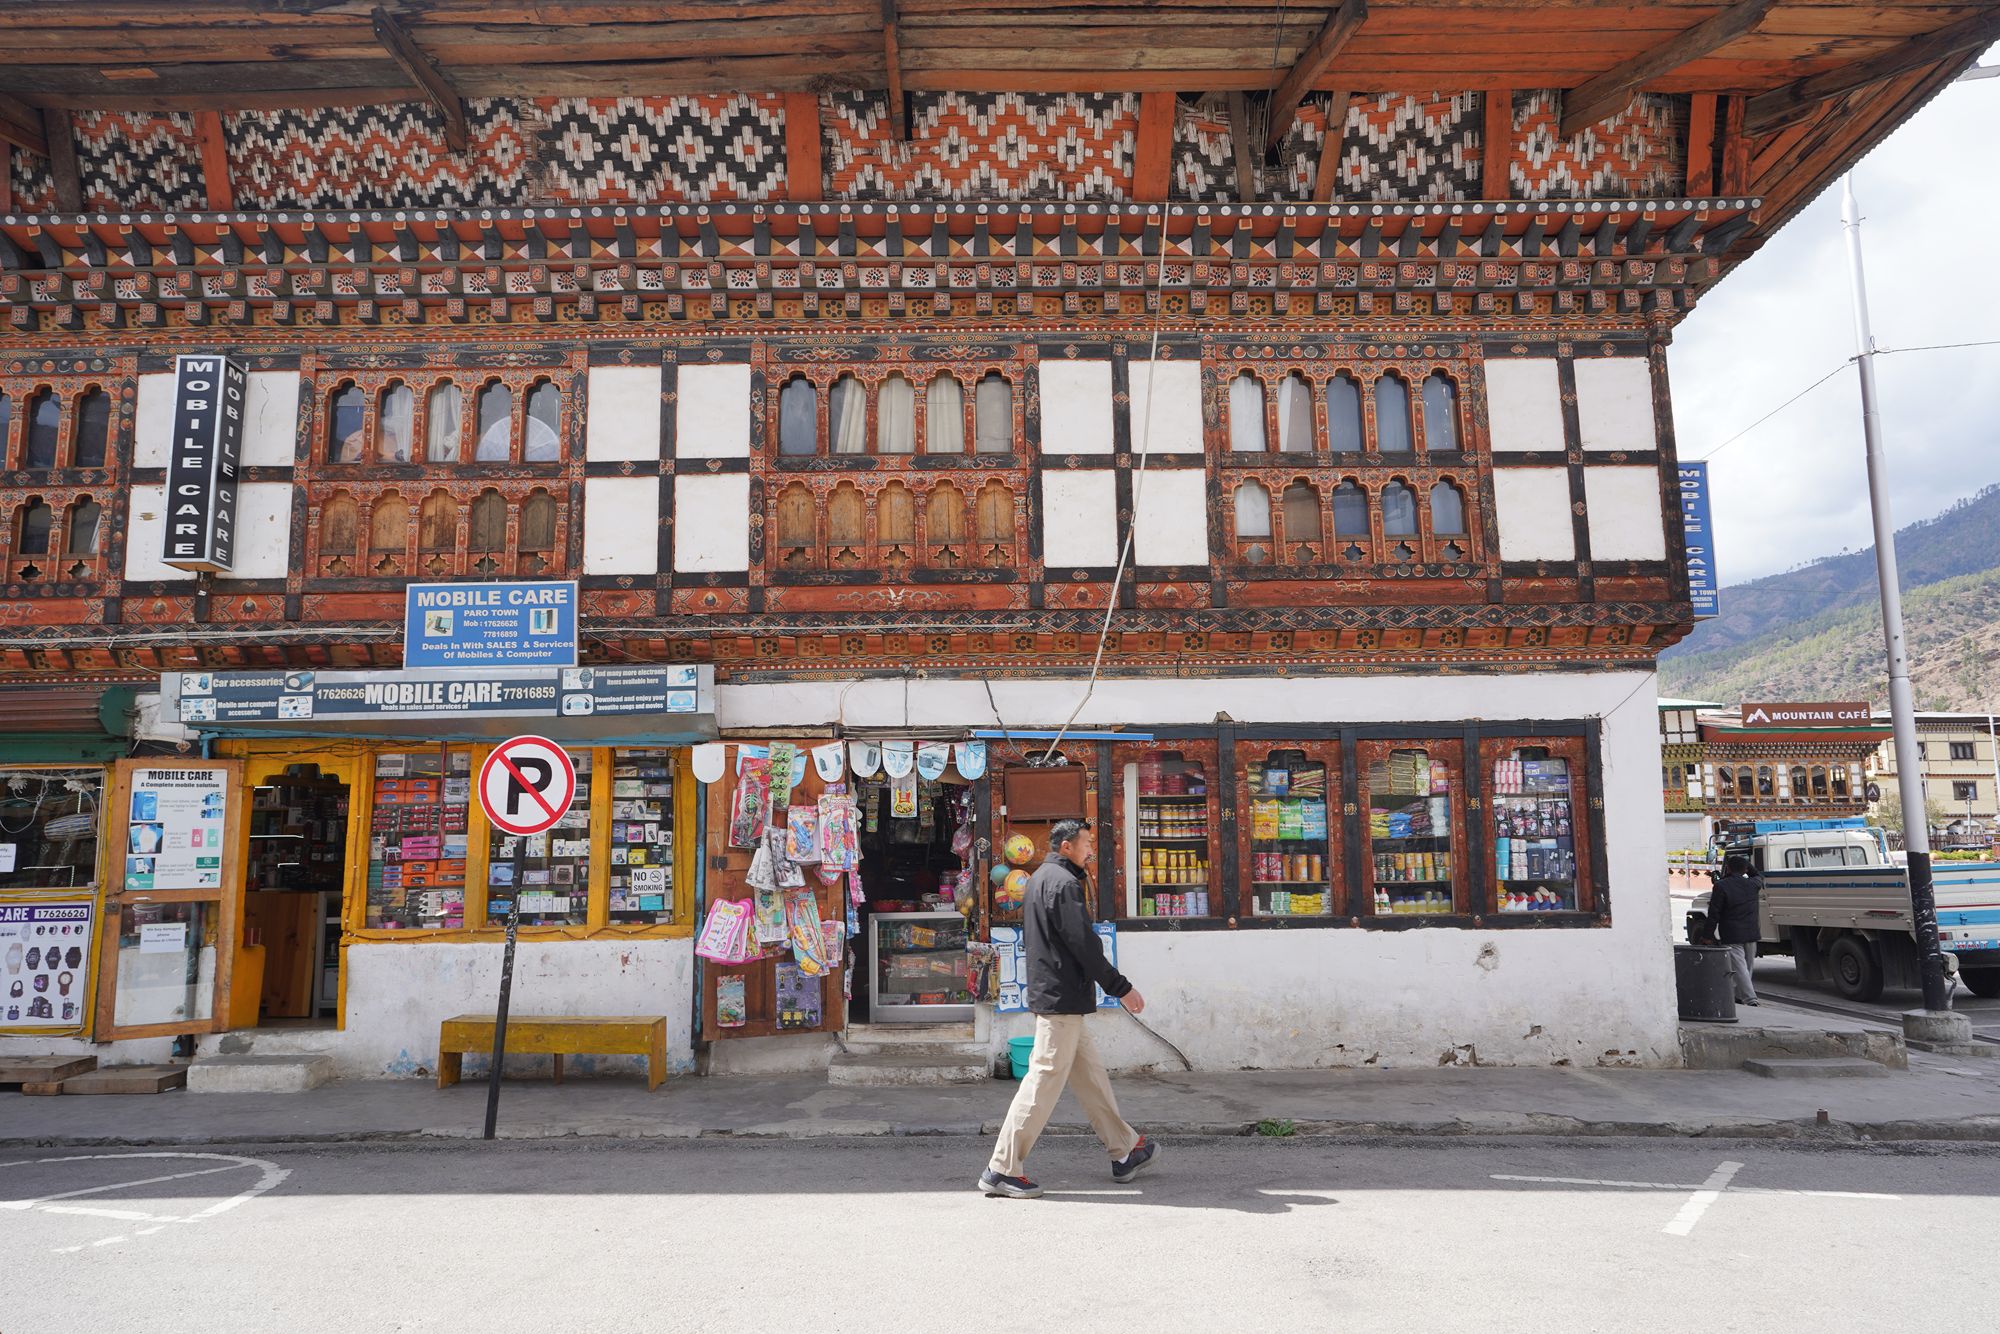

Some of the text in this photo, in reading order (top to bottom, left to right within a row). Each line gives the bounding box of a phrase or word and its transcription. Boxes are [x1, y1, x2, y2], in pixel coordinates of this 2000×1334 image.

[174, 361, 213, 555] MOBILE CARE
[216, 366, 243, 561] MOBILE CARE
[1678, 470, 1707, 588] MOBILE CARE
[417, 588, 568, 607] MOBILE CARE
[464, 609, 489, 617] PARO
[451, 642, 460, 650] In
[486, 641, 517, 649] SALES
[457, 650, 493, 658] Mobiles
[506, 650, 552, 659] Computer
[212, 678, 284, 688] Car accessories
[316, 682, 556, 704] 17626626 MOBILE CARE 77816859
[1772, 709, 1868, 720] MOUNTAIN CAFÉ
[148, 770, 213, 780] MOBILE CARE
[506, 757, 552, 815] P
[634, 872, 646, 881] NO
[38, 910, 85, 918] 17626626
[1954, 940, 1988, 949] WAIT
